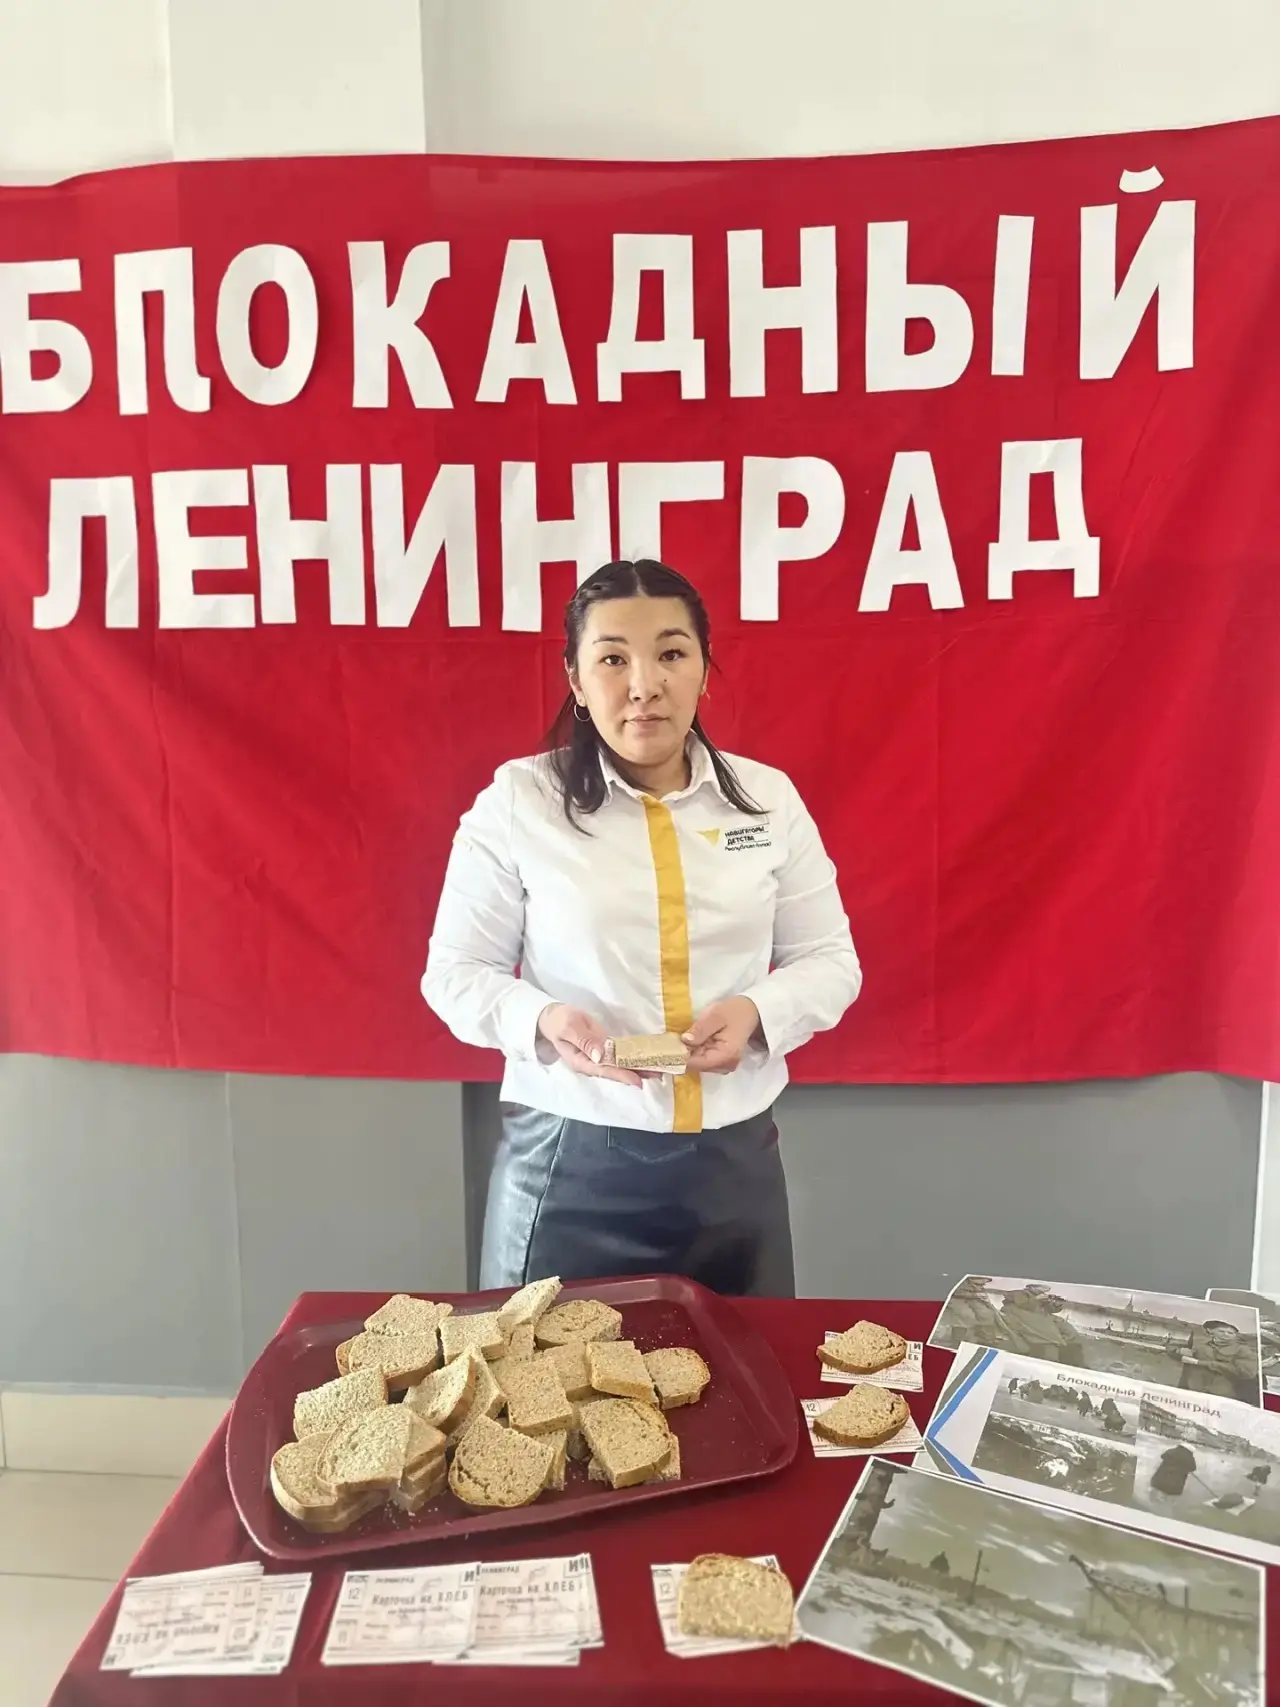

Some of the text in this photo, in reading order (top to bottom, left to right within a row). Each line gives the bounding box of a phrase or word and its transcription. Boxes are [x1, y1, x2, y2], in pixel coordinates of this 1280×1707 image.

[0, 166, 1196, 416] БЛОКАДНЫЙ
[33, 438, 1100, 632] ЛЕНИНГРАД
[727, 836, 755, 846] ДЕТСТВА
[1056, 1373, 1222, 1418] Блокадный Ленинград
[806, 1403, 817, 1412] 12
[480, 1585, 522, 1597] Карточка
[659, 1583, 671, 1595] 12
[371, 1594, 415, 1606] Карточка
